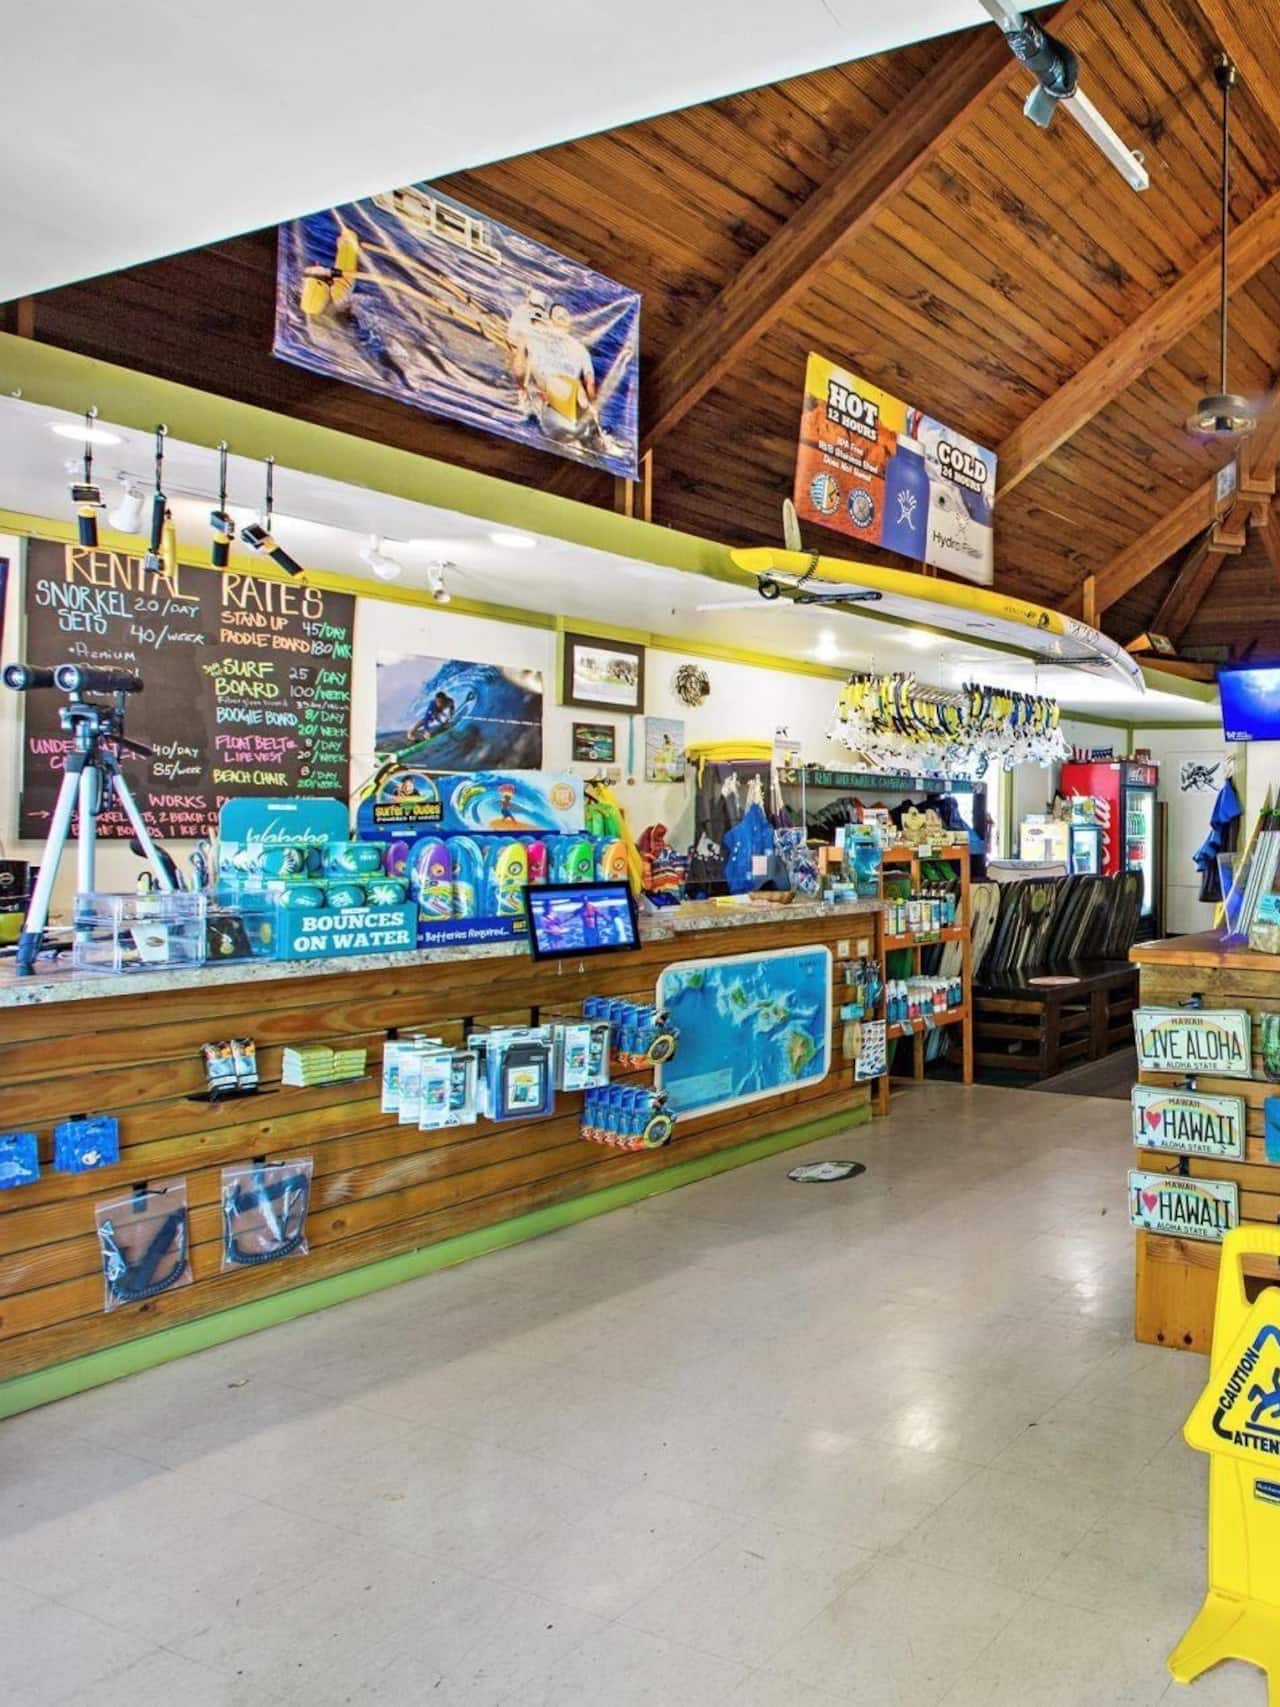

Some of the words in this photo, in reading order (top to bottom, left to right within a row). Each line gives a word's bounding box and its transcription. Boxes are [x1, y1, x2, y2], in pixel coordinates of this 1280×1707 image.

[830, 382, 878, 428] HOT
[828, 408, 840, 422] 12
[842, 414, 877, 440] HOURS
[938, 442, 987, 483] COLD
[942, 464, 953, 478] 24
[65, 543, 201, 601] RENTAL
[221, 573, 324, 619] RATES
[35, 580, 134, 618] SNORKEL
[58, 608, 107, 635] SETS
[220, 610, 267, 628] STAND
[270, 614, 289, 631] UP
[219, 628, 271, 648] PADDLE
[272, 634, 310, 654] BOARD
[223, 658, 274, 679] SURF
[215, 677, 280, 699] BOARD
[215, 735, 253, 751] FLOAT
[255, 735, 287, 752] BELT
[213, 769, 250, 785] BEACH
[252, 770, 288, 787] CHAIR
[149, 794, 207, 807] WORKS
[302, 911, 406, 933] BOUNCES
[293, 936, 327, 952] ON
[331, 929, 410, 950] WATER
[425, 930, 467, 943] Batteries
[1140, 1028, 1182, 1059] LIVE
[1187, 1030, 1242, 1060] ALOHA
[1138, 1105, 1147, 1135] I
[1162, 1109, 1235, 1146] HAWAII
[1134, 1187, 1143, 1216] I
[1159, 1191, 1231, 1229] HAWAII
[1219, 1347, 1259, 1410] CAUTION
